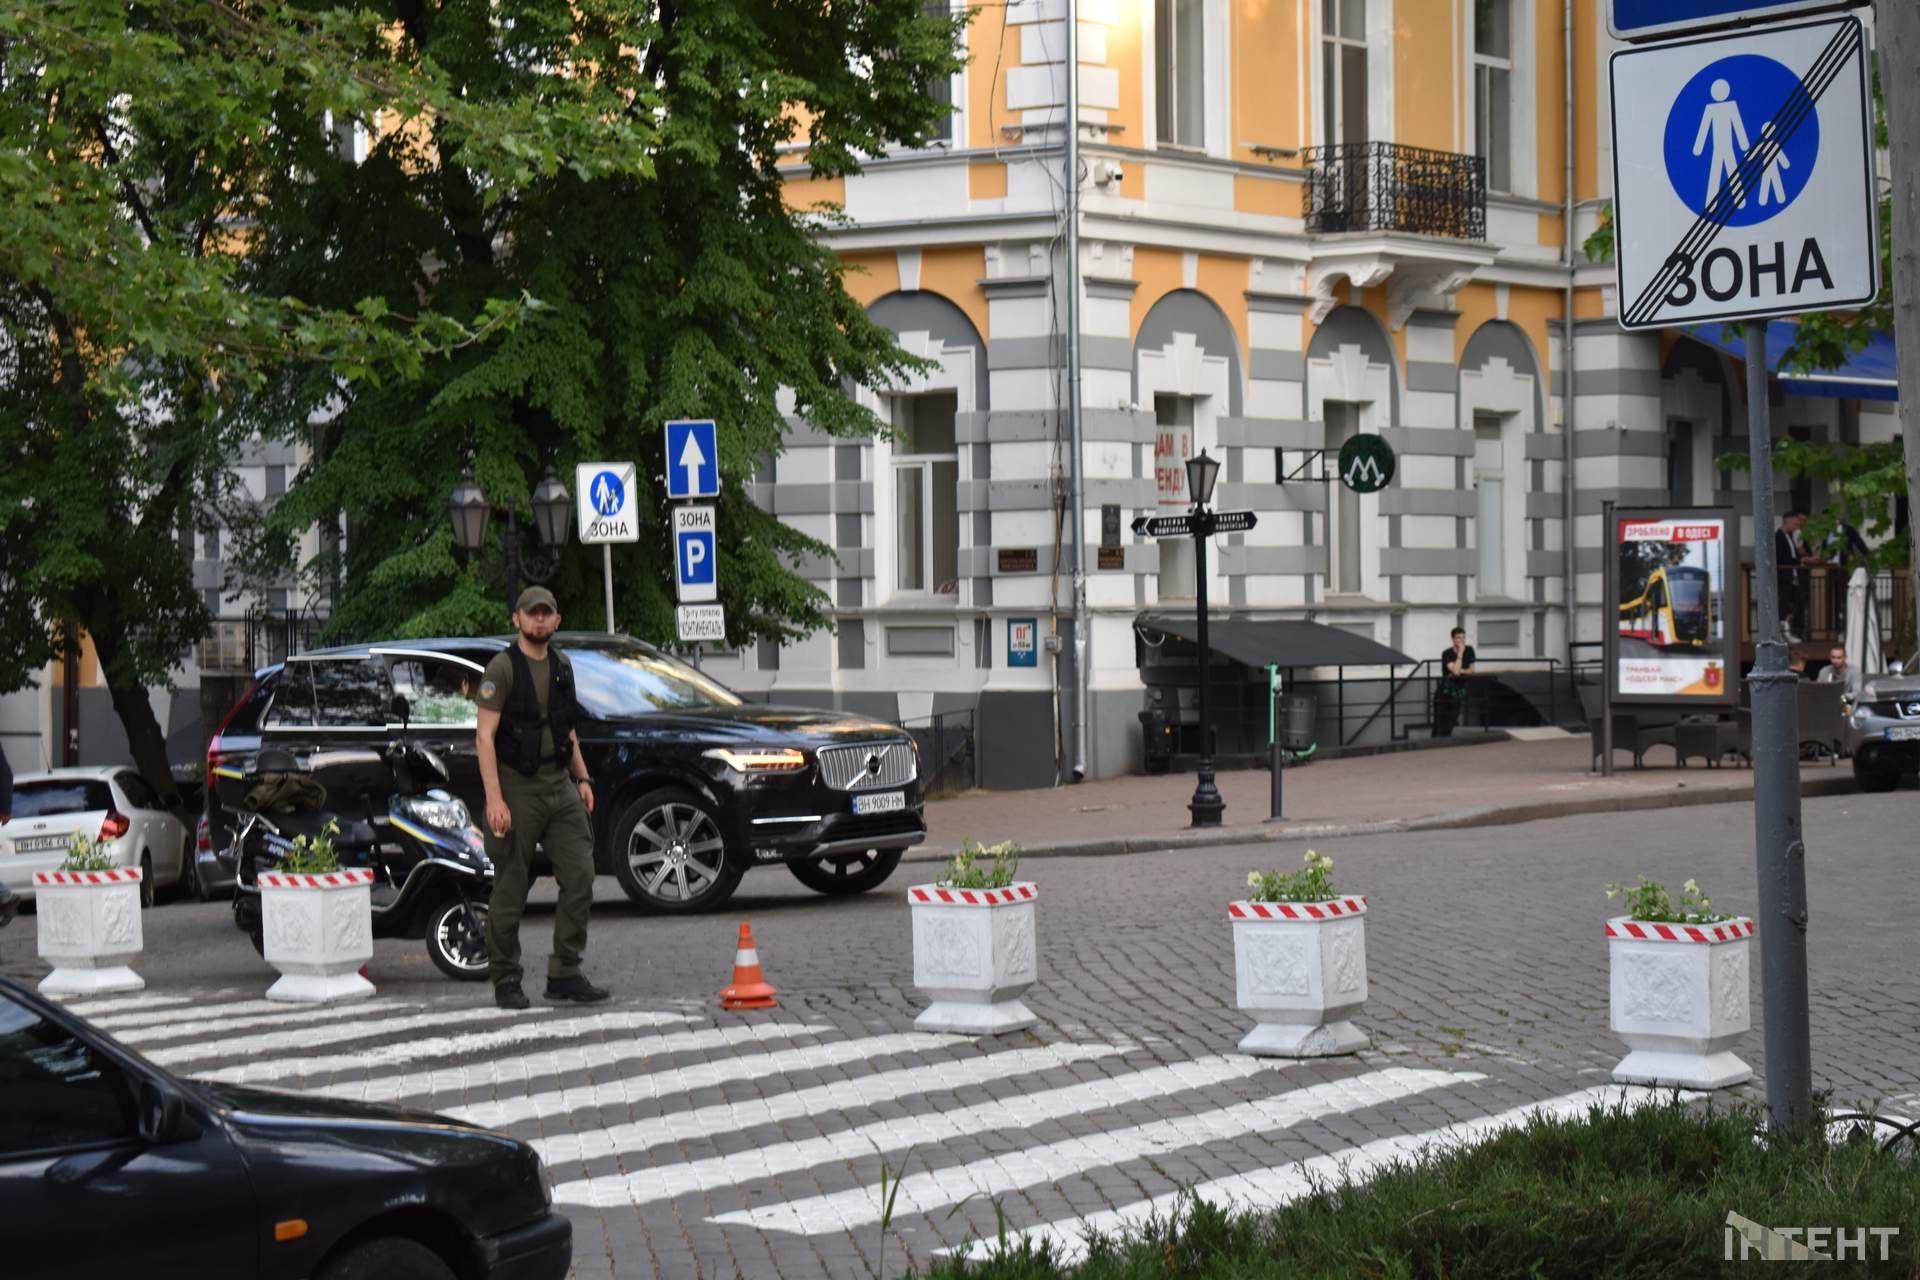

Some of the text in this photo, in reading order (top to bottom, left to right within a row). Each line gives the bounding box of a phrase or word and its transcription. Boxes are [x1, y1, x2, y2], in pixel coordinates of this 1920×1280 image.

[1664, 237, 1835, 307] ЗОНА
[680, 512, 711, 527] ЗОНА
[591, 521, 629, 537] ЗОНА
[686, 538, 706, 578] P
[872, 795, 890, 809] 9009
